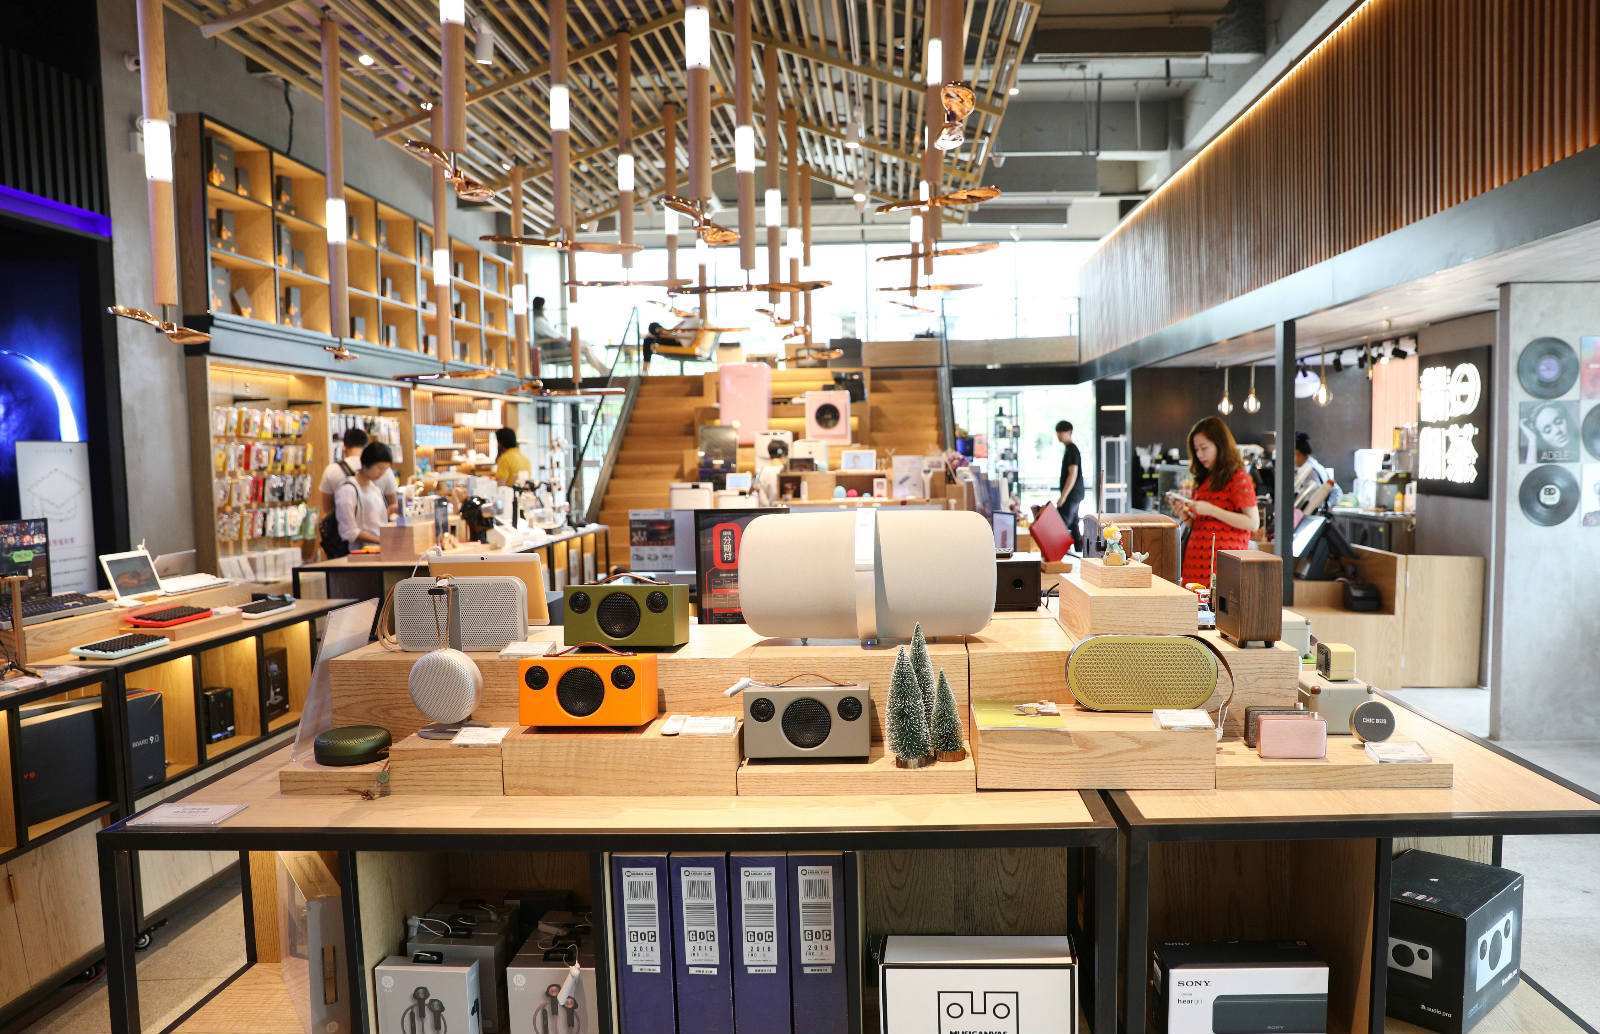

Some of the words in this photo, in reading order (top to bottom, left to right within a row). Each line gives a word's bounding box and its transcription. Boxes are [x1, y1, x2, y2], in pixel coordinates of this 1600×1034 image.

[629, 930, 656, 942] GOC
[688, 930, 715, 942] GOC
[746, 930, 774, 942] GOC
[804, 929, 832, 942] GOC
